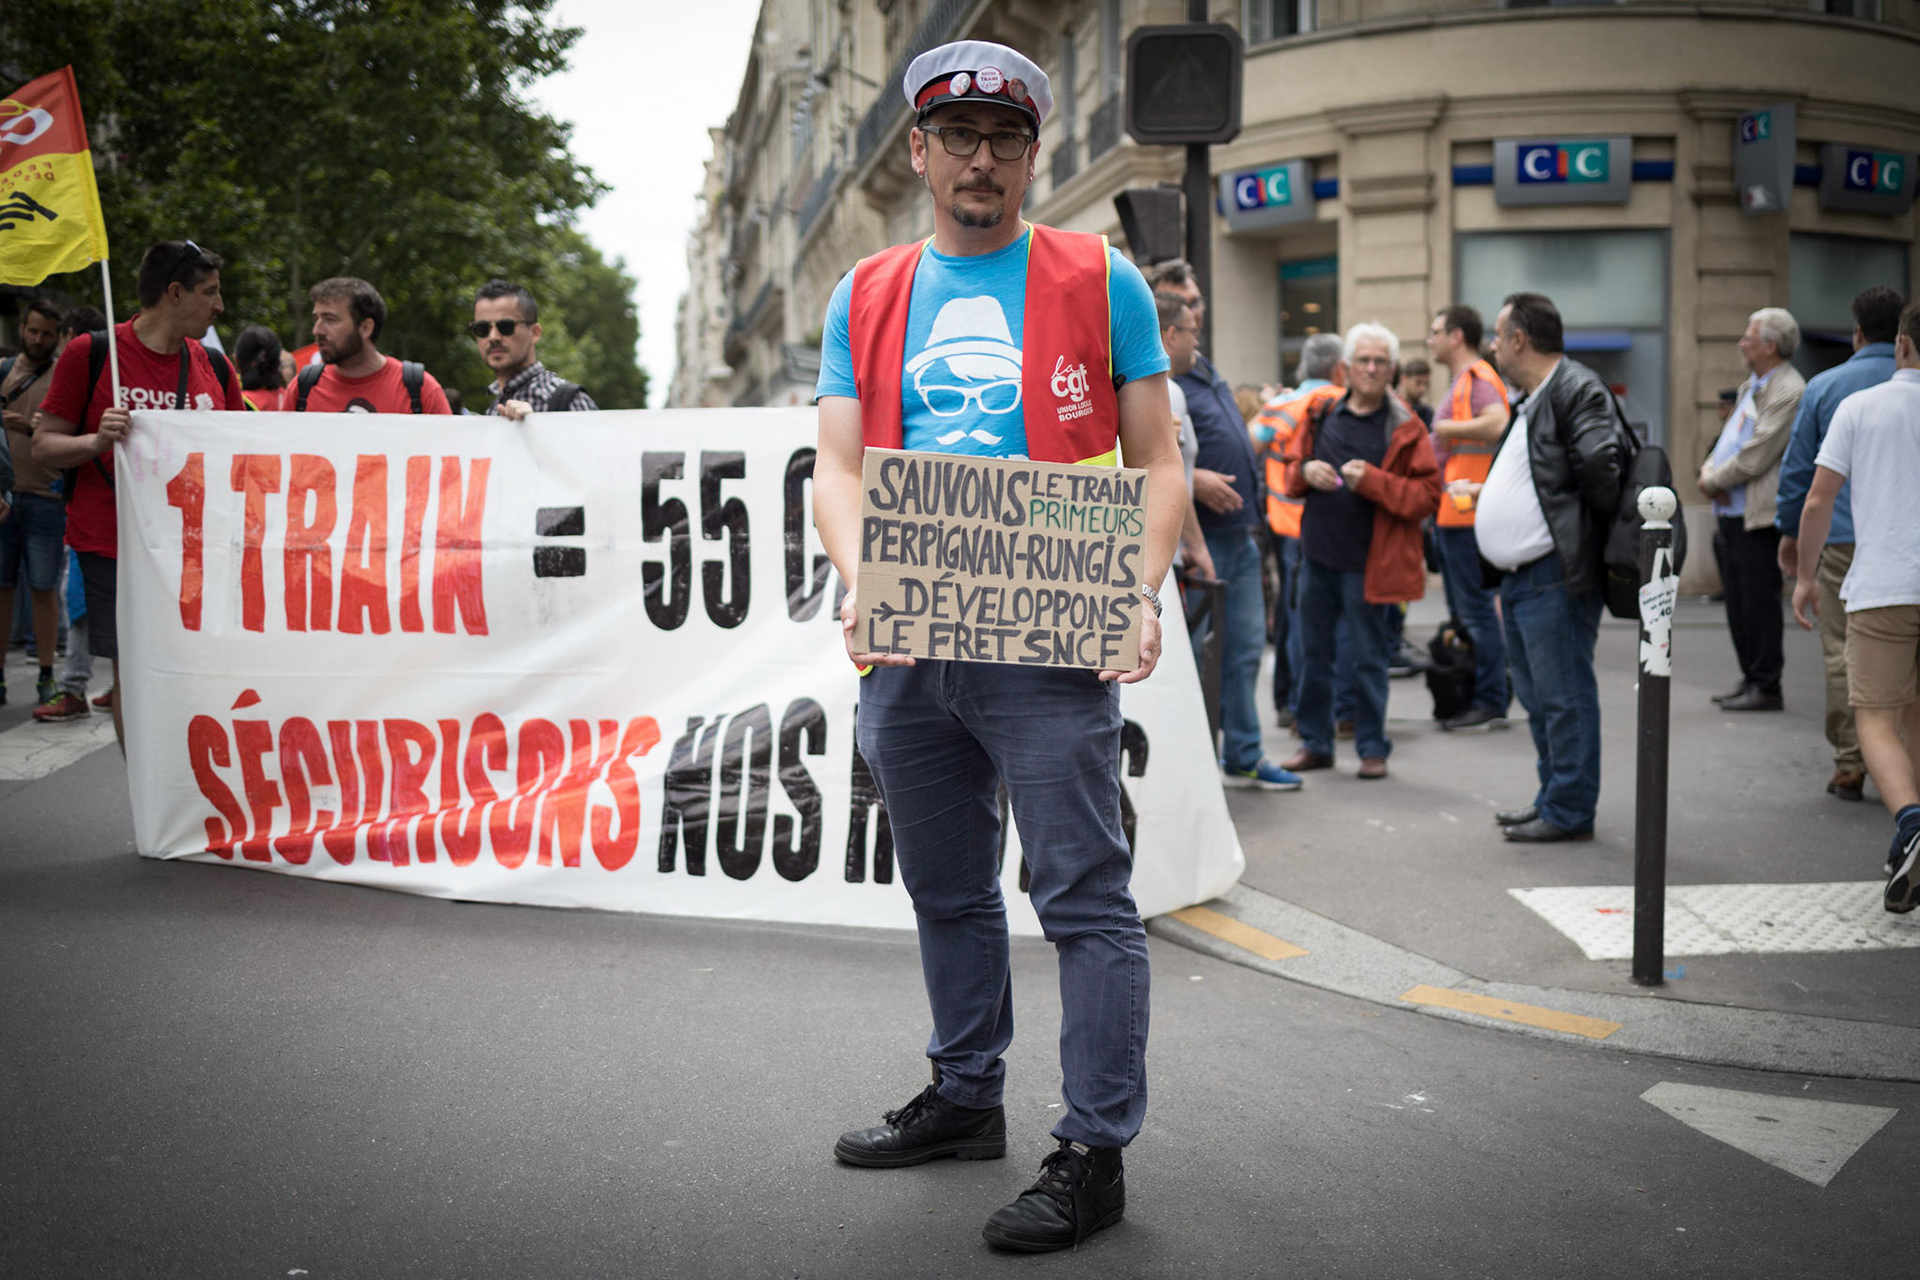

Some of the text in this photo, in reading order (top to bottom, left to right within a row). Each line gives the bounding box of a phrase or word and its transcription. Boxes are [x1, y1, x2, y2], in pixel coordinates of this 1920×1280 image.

[1741, 114, 1769, 141] CIC
[1523, 147, 1602, 180] CIC
[1851, 156, 1900, 190] CIC
[1236, 172, 1288, 208] CIC
[1051, 363, 1090, 402] cgt
[1056, 404, 1078, 414] UNION
[868, 457, 1030, 527] SAUVONS
[1031, 470, 1063, 498] LE
[166, 452, 205, 632] 1
[230, 453, 492, 636] TRAIN
[640, 450, 752, 631] 55
[897, 572, 1138, 632] DÉVELOPPONS
[868, 617, 1123, 668] LE FRET SNCF
[187, 688, 662, 871] SÉCURISONS
[657, 697, 828, 882] NOS
